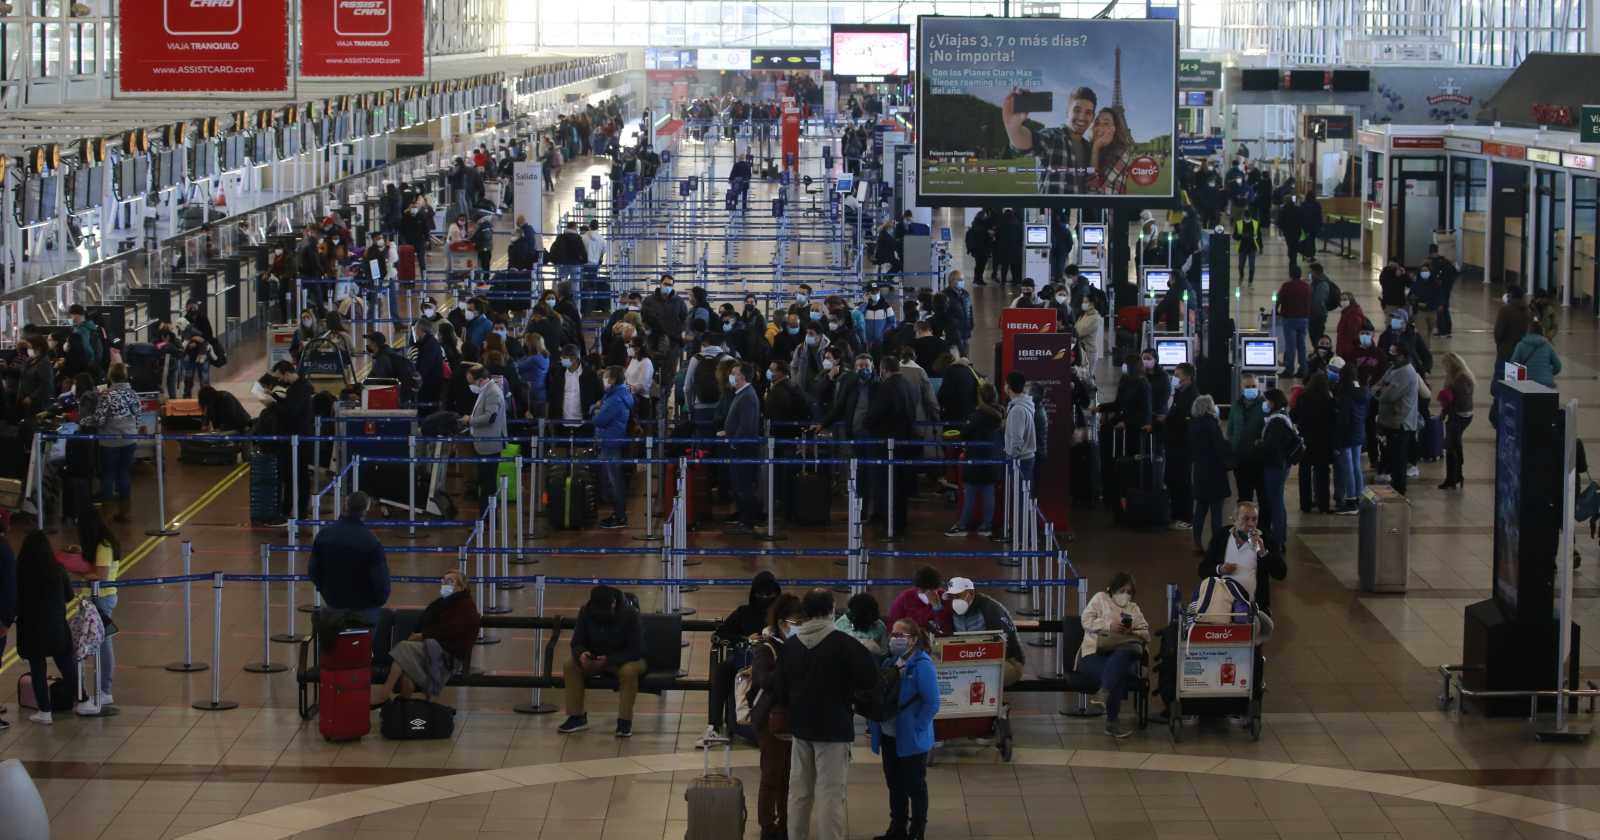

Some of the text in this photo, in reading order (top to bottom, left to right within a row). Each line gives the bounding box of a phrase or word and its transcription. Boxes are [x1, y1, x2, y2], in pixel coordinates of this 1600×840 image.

[353, 8, 386, 16] CARD
[167, 42, 239, 50] VIAJA TRANQUILO
[929, 34, 1088, 49] ¿Viajas 3, 7 o más días?
[929, 50, 1015, 64] ¡No importa!
[153, 66, 255, 74] www.ASSISTCARD.com
[932, 68, 949, 77] Con
[963, 68, 991, 77] Planes
[992, 68, 1015, 77] Claro
[1016, 68, 1033, 77] Max
[932, 78, 958, 87] Tienes
[960, 79, 993, 88] roaming
[1592, 126, 1600, 134] E
[1131, 166, 1154, 176] Claro
[1205, 629, 1229, 640] Claro
[959, 649, 984, 658] Claro
